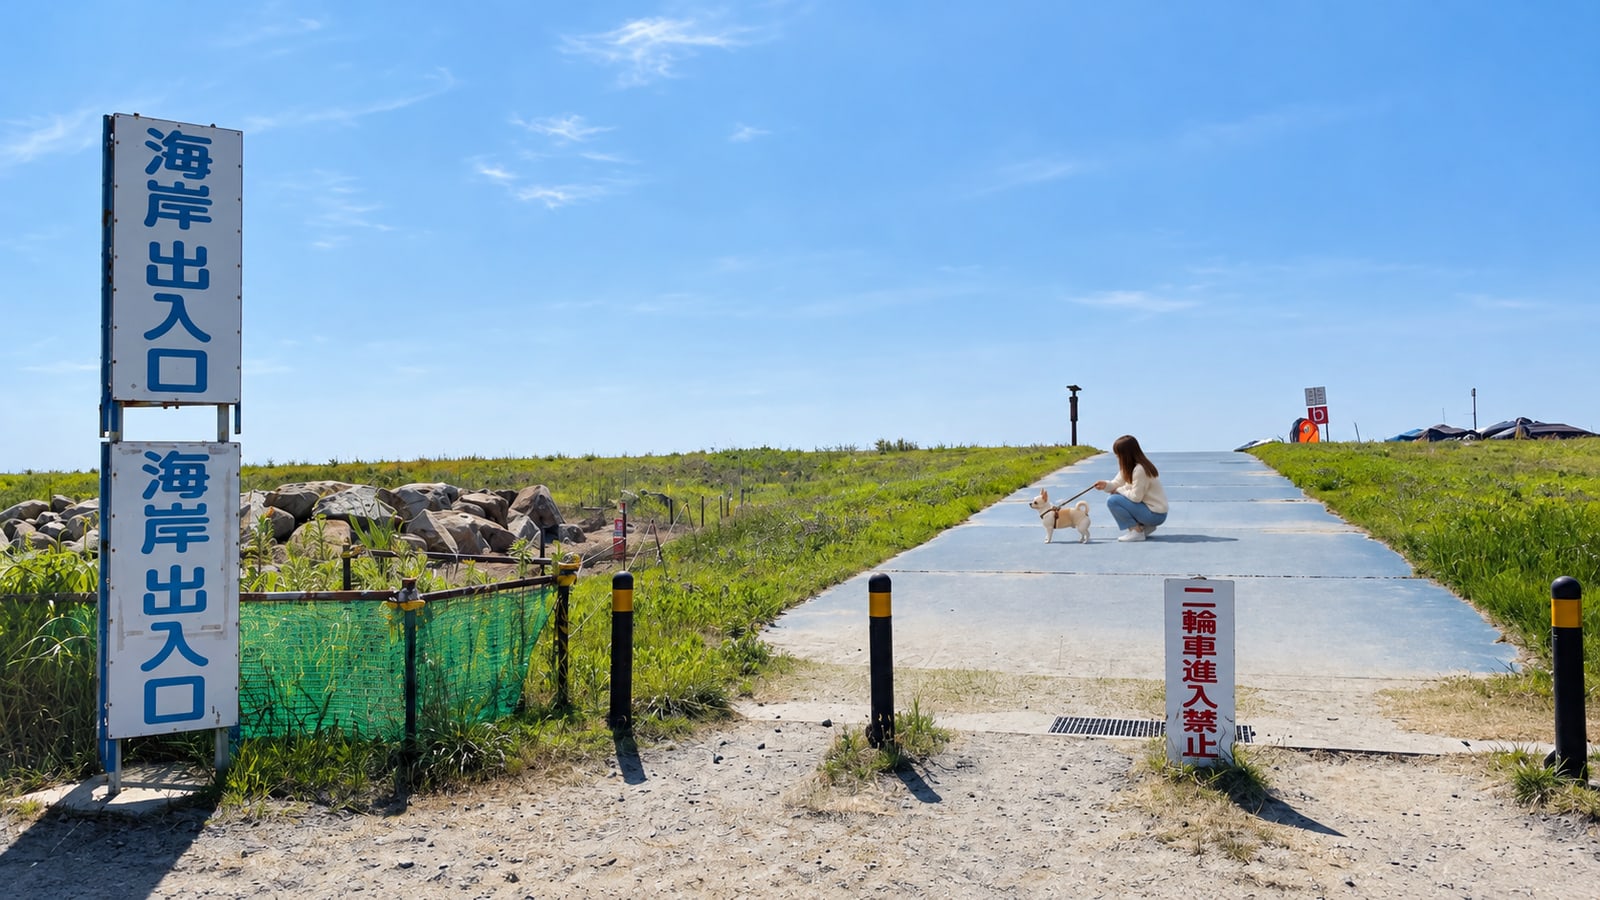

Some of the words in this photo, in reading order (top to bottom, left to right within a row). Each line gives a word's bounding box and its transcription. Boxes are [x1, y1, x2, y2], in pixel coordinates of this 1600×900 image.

[143, 127, 213, 393] 海岸出入口
[140, 450, 210, 725] 海岸出入口
[1182, 587, 1219, 758] 二輪車進入禁止
